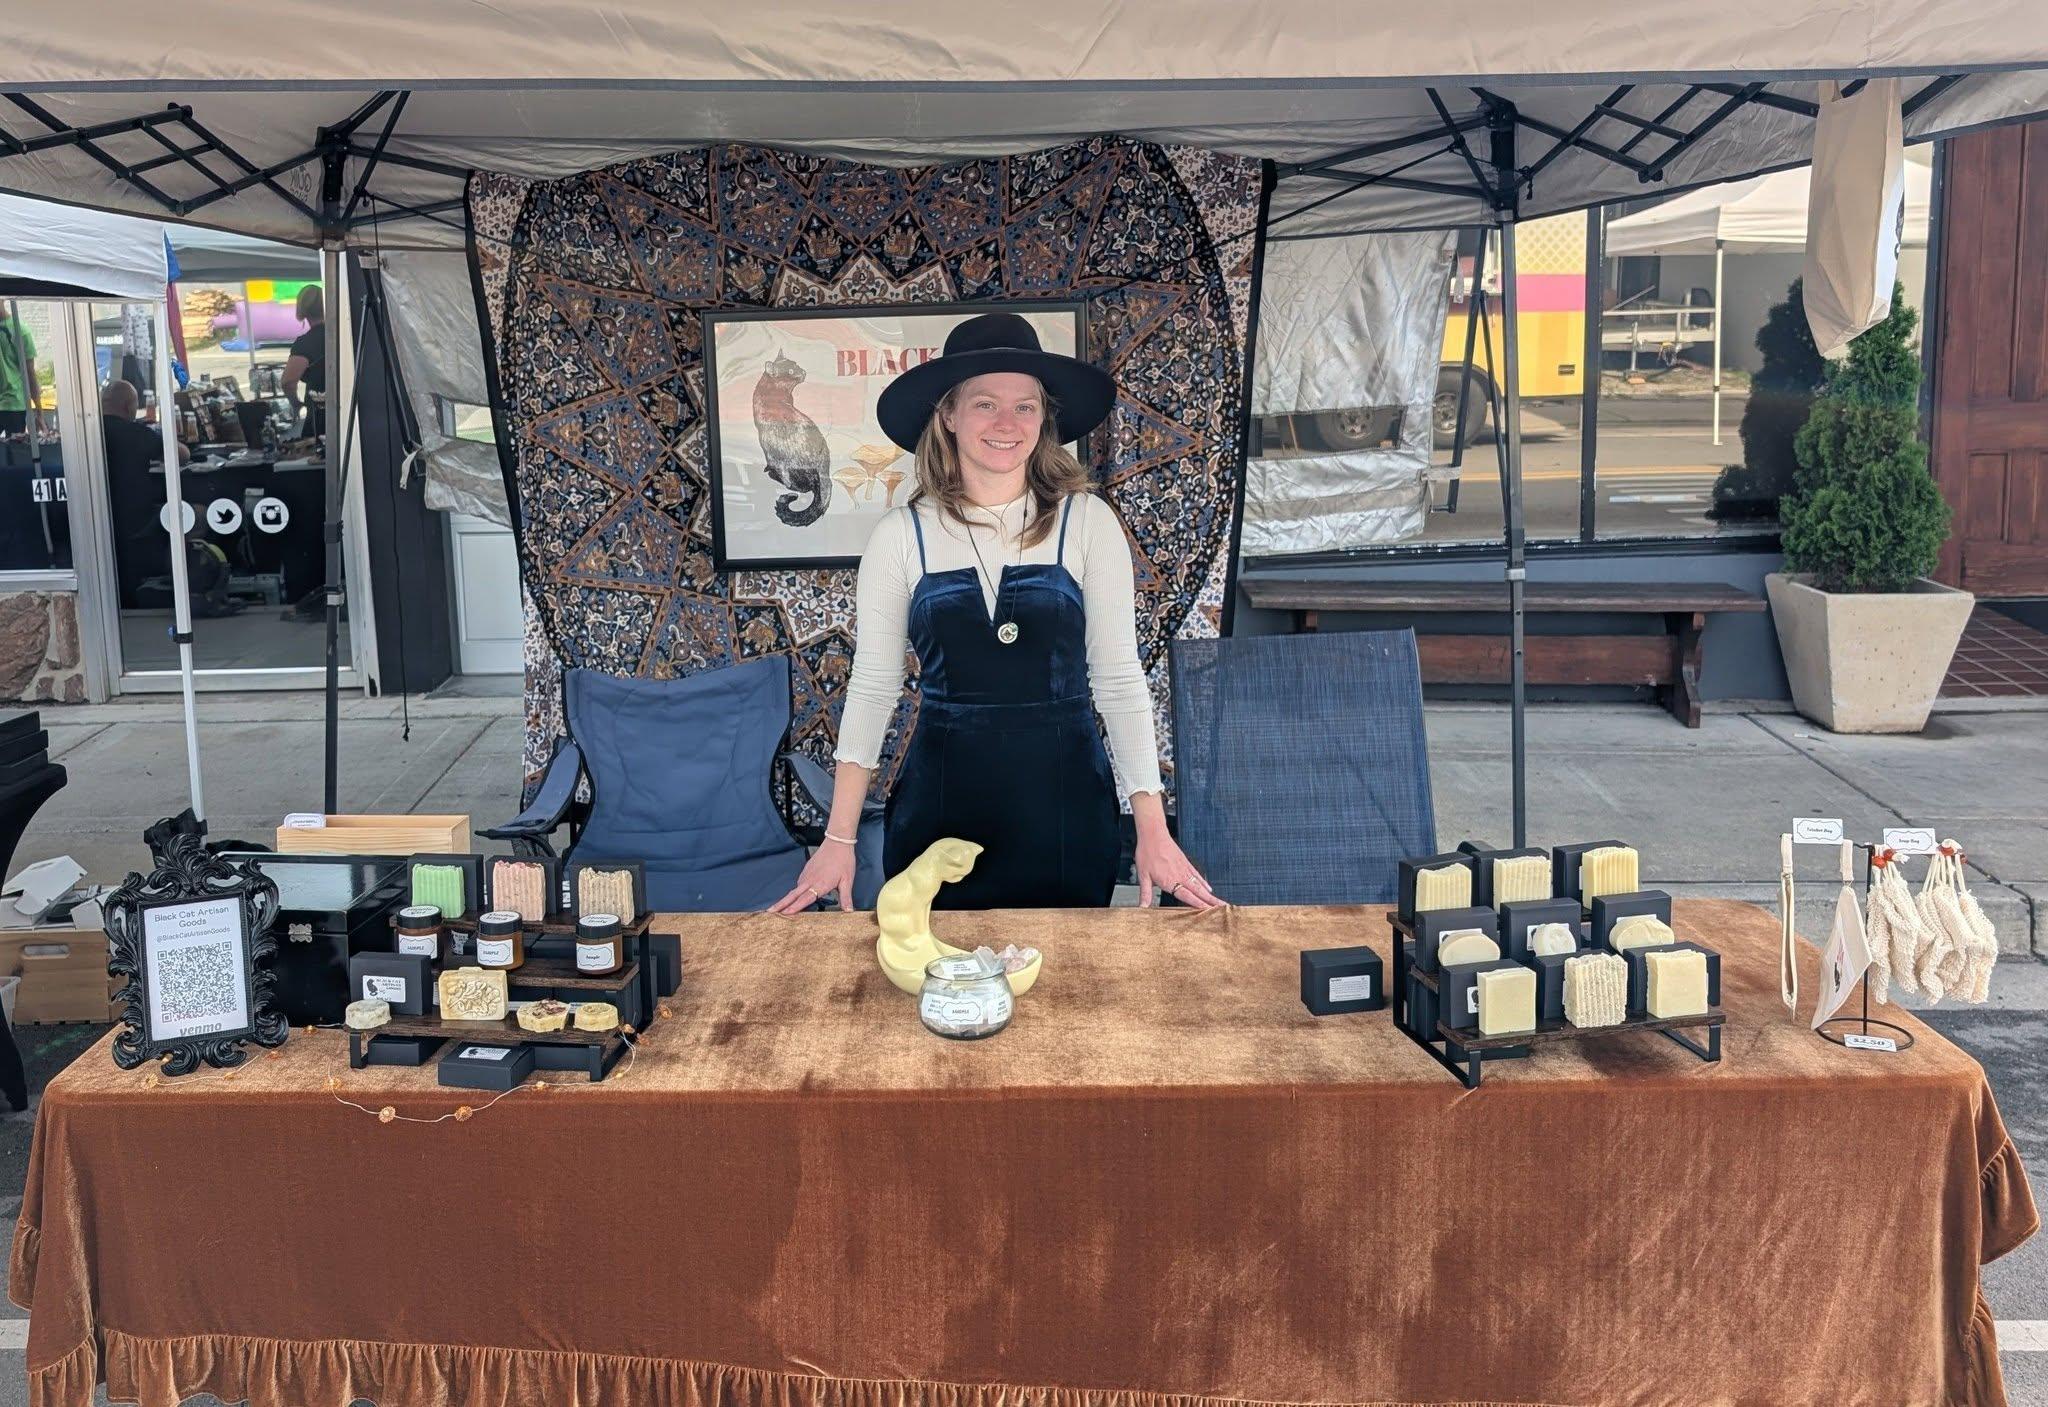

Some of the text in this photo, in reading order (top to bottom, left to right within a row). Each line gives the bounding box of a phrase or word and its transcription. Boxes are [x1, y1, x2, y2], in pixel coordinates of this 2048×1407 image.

[154, 906, 230, 923] Black Cat Artisan
[178, 917, 207, 928] Goods
[179, 1021, 223, 1037] venmo
